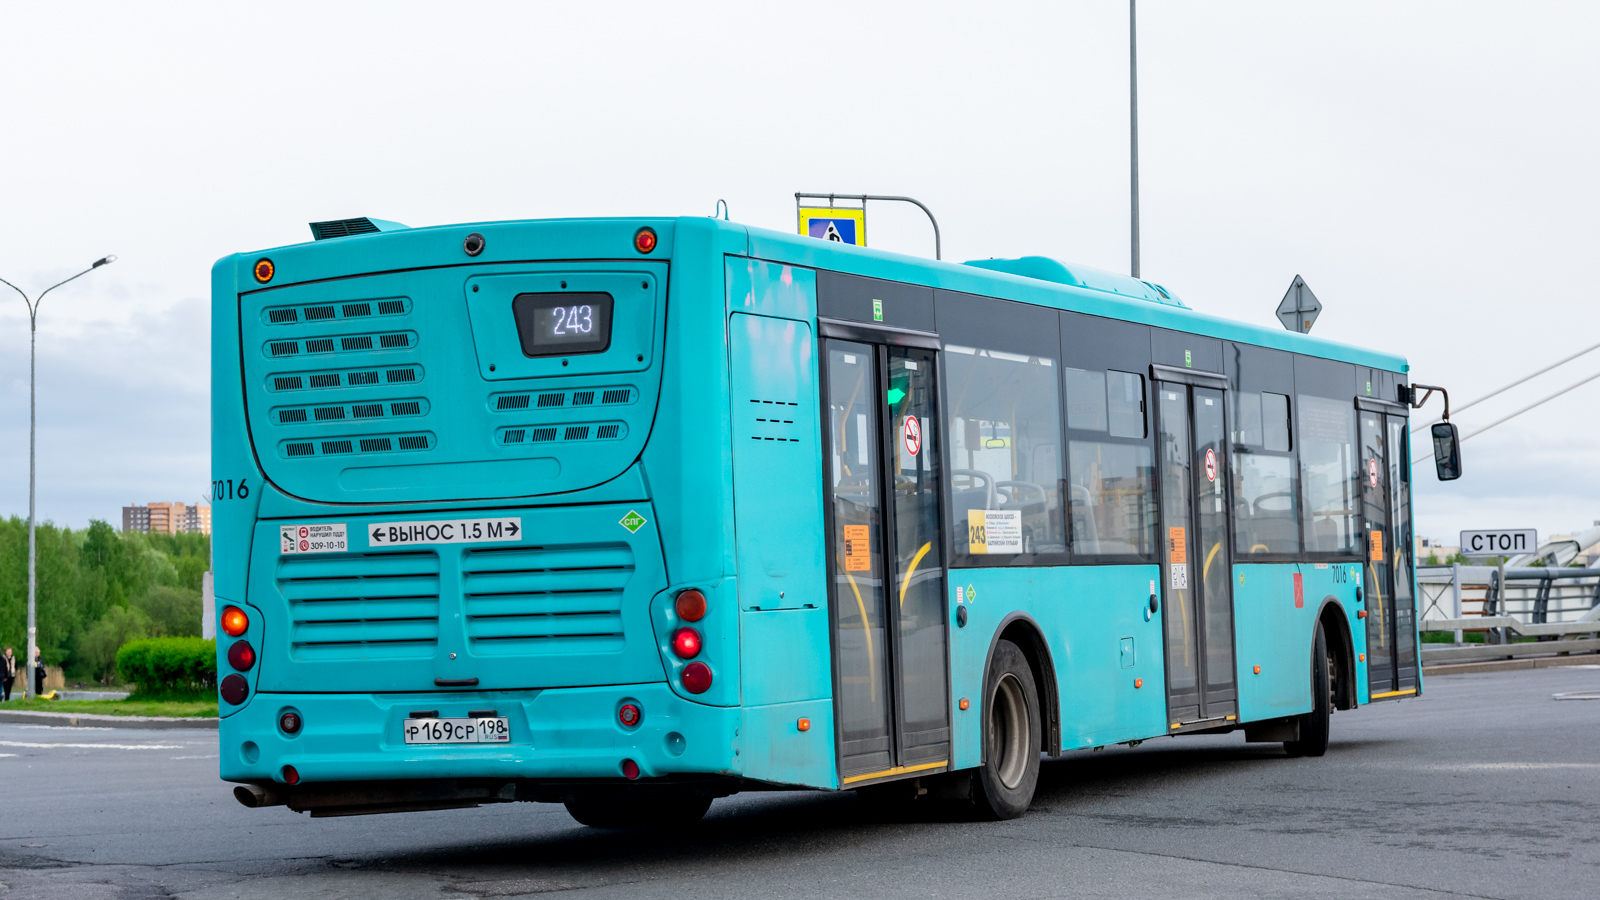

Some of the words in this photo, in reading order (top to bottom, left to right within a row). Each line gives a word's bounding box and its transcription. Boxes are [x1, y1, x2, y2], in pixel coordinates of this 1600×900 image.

[553, 305, 592, 334] 243
[212, 478, 249, 501] 7016
[624, 518, 640, 526] СПГ
[389, 524, 454, 542] ВЫНОС
[461, 523, 482, 539] 1.5
[487, 522, 503, 538] М
[970, 525, 986, 544] 243
[310, 541, 345, 550] 309-10-10
[1471, 533, 1525, 551] СТОП
[1332, 565, 1347, 584] 7016
[479, 719, 504, 734] 198
